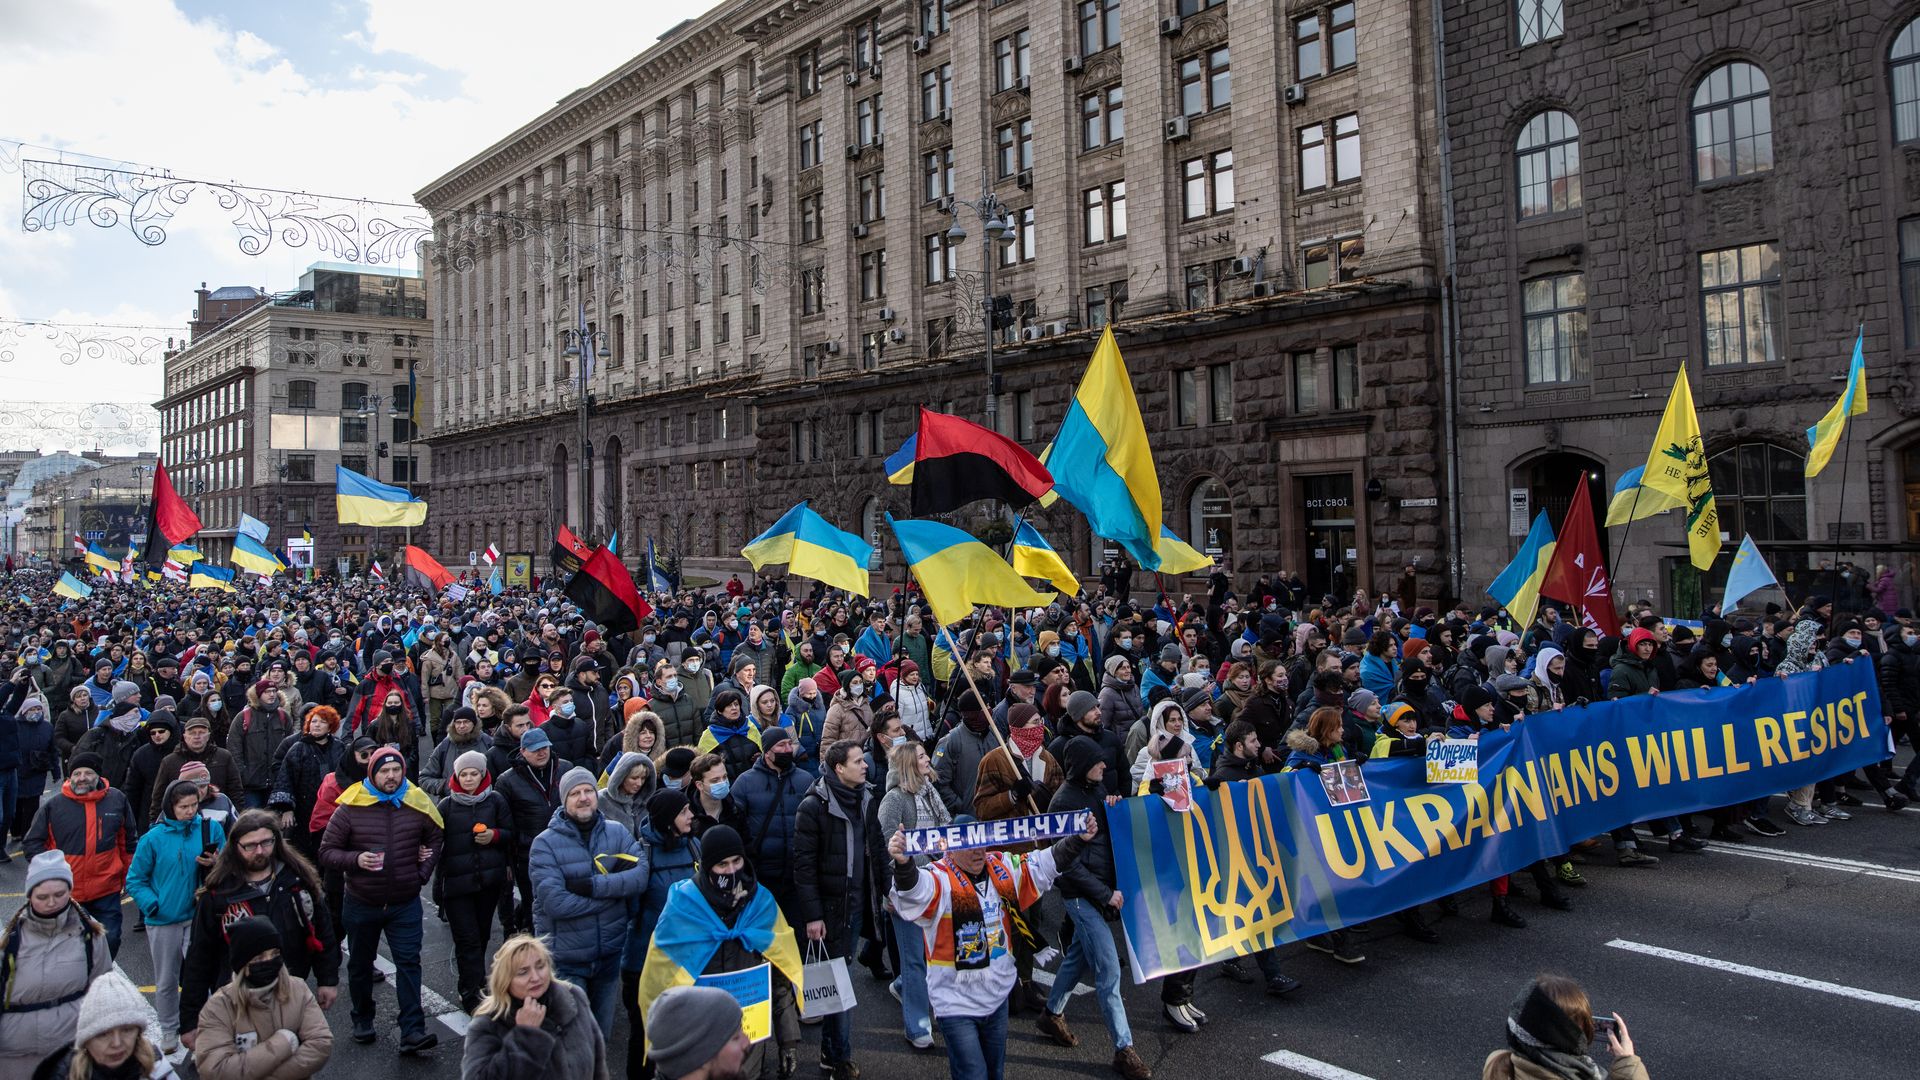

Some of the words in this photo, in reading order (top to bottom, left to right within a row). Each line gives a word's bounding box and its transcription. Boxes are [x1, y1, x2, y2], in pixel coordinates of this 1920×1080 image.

[1664, 465, 1681, 479] НЕ
[1315, 741, 1619, 880] UKRAINIANS
[1626, 723, 1750, 789] WILL
[1754, 691, 1870, 768] RESIST
[905, 812, 1088, 852] КРЕМЕНЧУК
[803, 985, 839, 1002] HILYOVA
